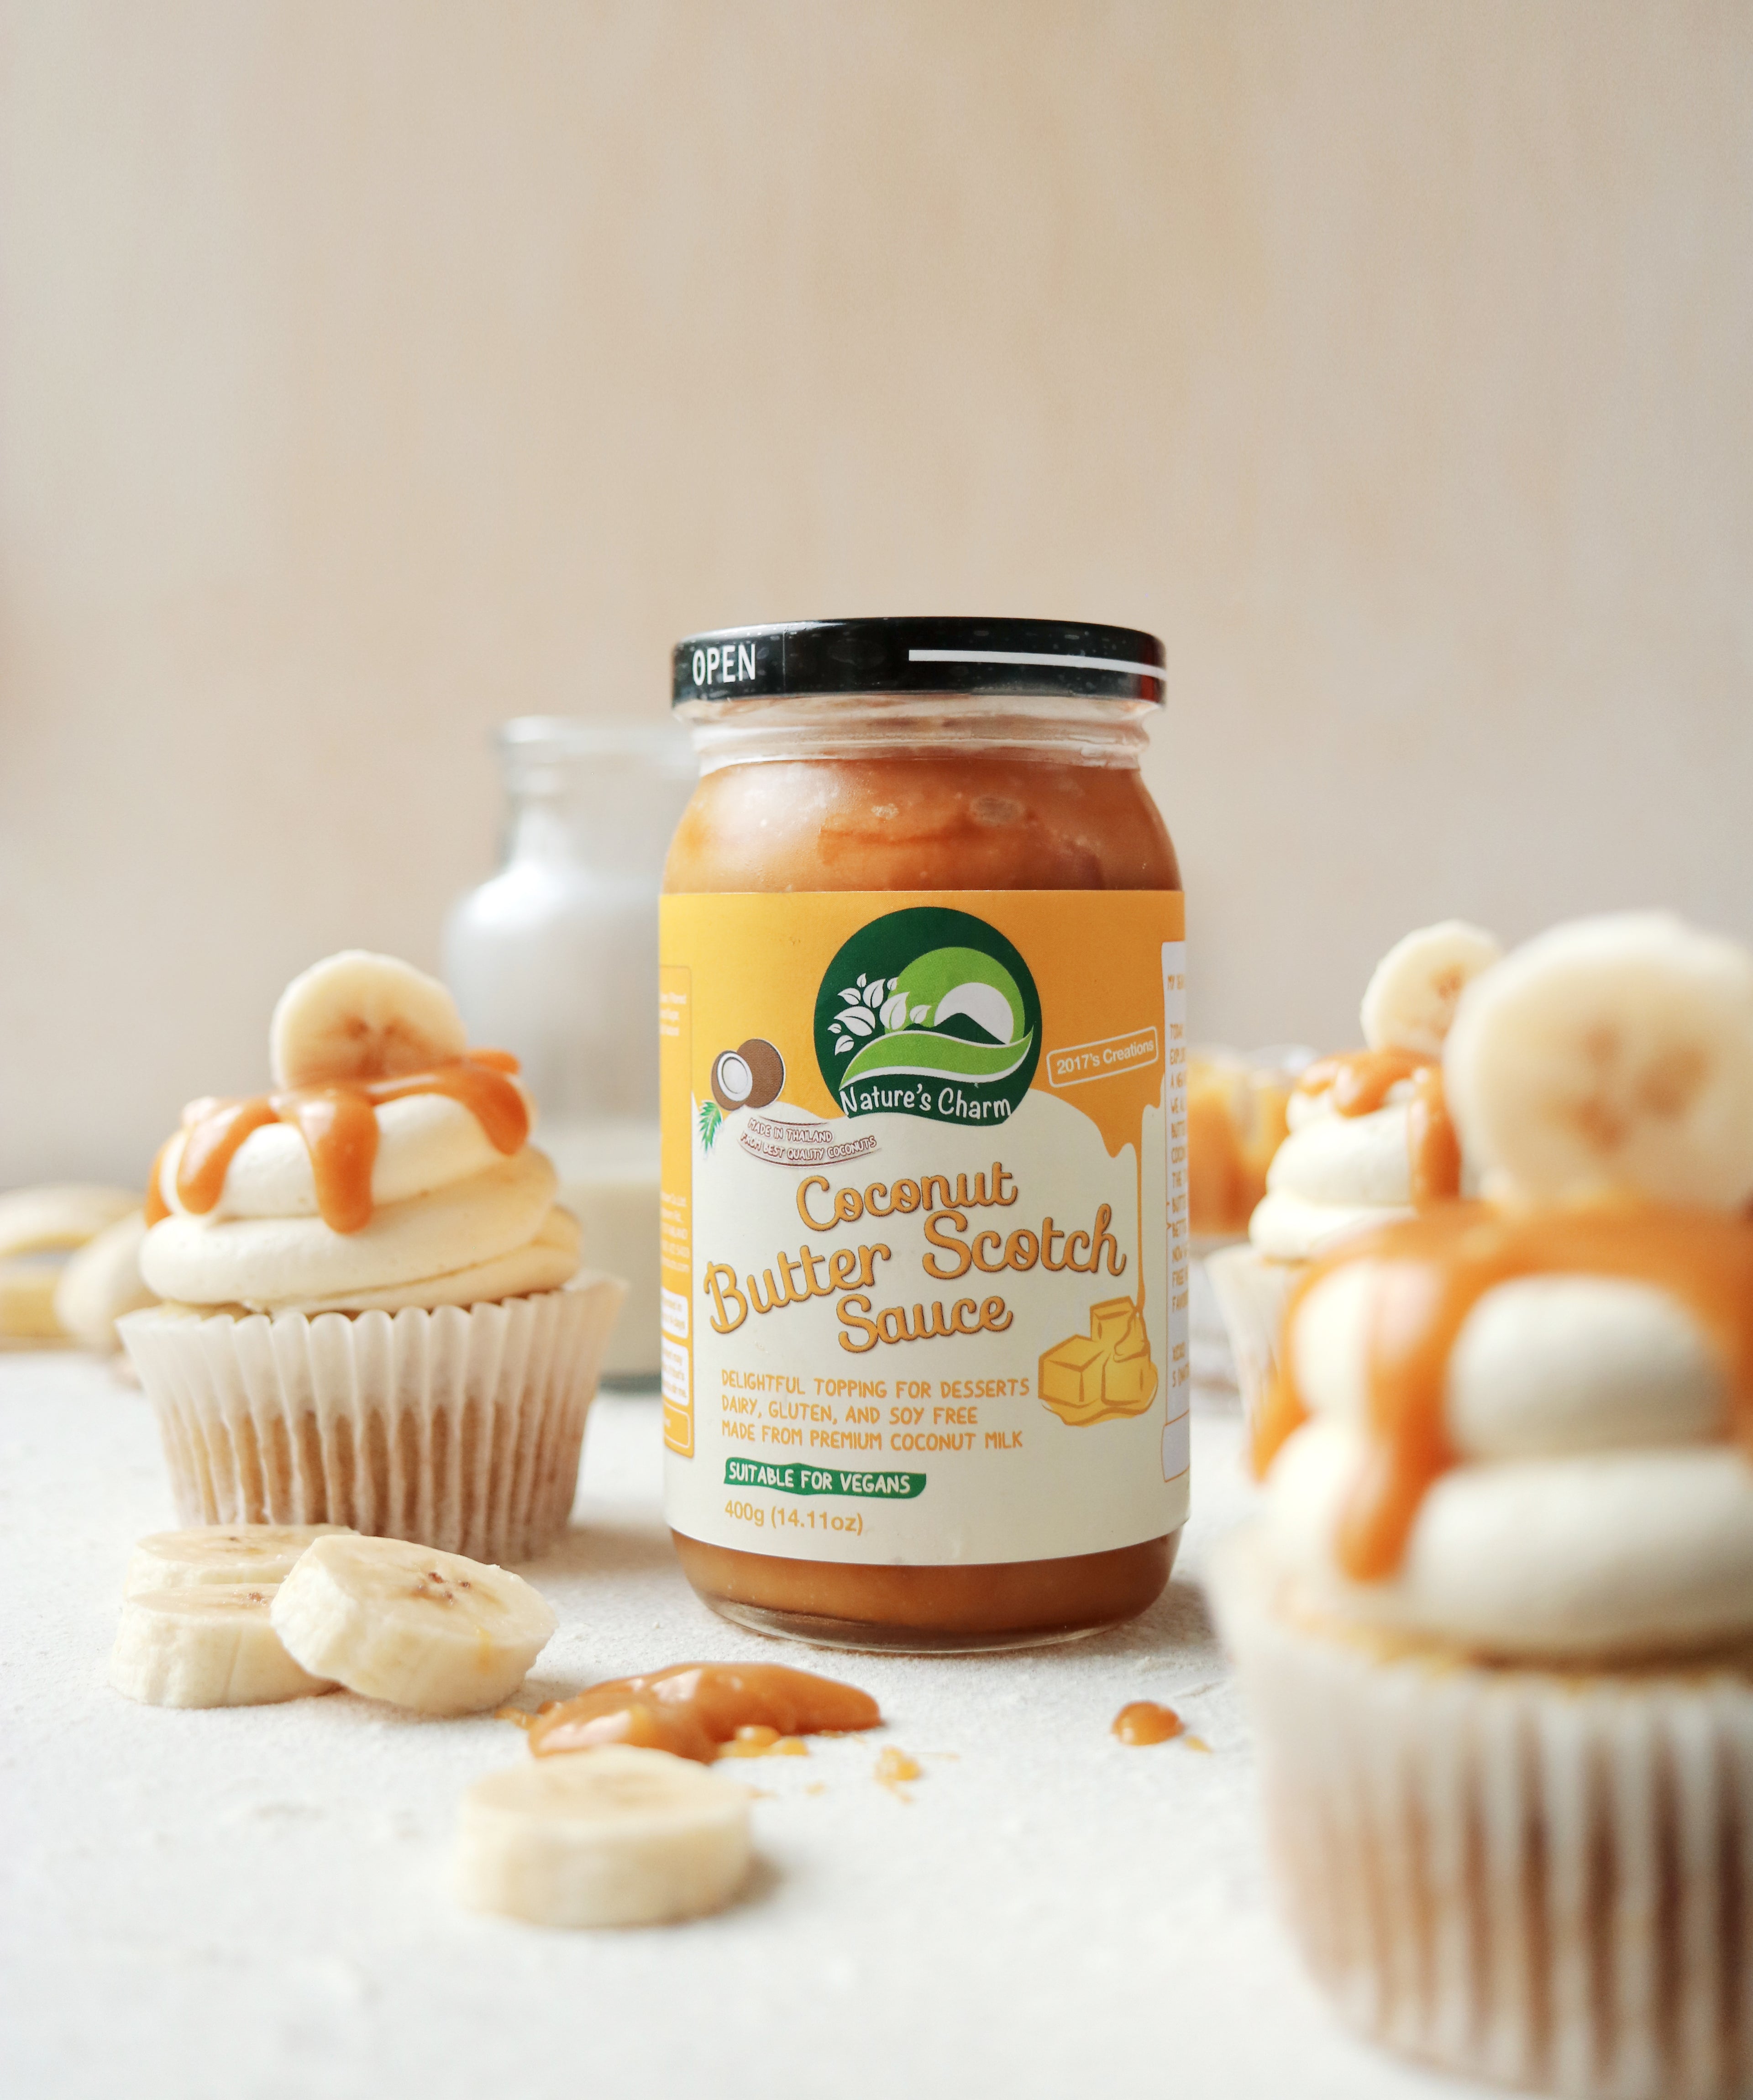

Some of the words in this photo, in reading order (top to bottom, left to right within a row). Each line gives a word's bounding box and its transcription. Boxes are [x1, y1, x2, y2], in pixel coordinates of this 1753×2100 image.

[693, 644, 755, 686] OPEN
[1057, 1053, 1100, 1075] 2017's
[1103, 1040, 1154, 1064] Creations
[839, 1083, 931, 1115] Nature's
[938, 1087, 1011, 1119] Charm
[740, 1132, 762, 1150] FROM
[762, 1141, 785, 1158] BEST
[787, 1147, 824, 1160] QUALITY
[827, 1135, 877, 1159] COCONUTS
[748, 1118, 771, 1138] MADE
[774, 1128, 784, 1139] IN
[787, 1129, 834, 1143] THAILAND
[797, 1161, 1018, 1232] Coconut
[703, 1243, 892, 1334] Butter
[922, 1203, 1127, 1280] Scotch
[836, 1293, 1013, 1353] Sauce
[721, 1369, 805, 1395] DELIGHTFUL
[814, 1378, 887, 1399] TOPPING
[896, 1381, 931, 1399] FOR
[940, 1377, 1029, 1399] DESSERTS
[721, 1395, 762, 1418] DAIRY,
[769, 1401, 838, 1425] GLUTEN,
[845, 1407, 880, 1425] AND
[889, 1407, 925, 1425] SOY
[934, 1407, 978, 1425] FREE
[721, 1420, 755, 1441] MADE
[762, 1425, 802, 1446] FROM
[810, 1430, 882, 1450] PREMIUM
[891, 1432, 976, 1451] COCONUT
[985, 1430, 1023, 1449] MILK
[729, 1461, 794, 1488] SUITABLE
[801, 1470, 832, 1490] FOR
[840, 1473, 911, 1494] VEGANS
[724, 1500, 764, 1527] 400g
[771, 1506, 863, 1536] (14.11oz)
